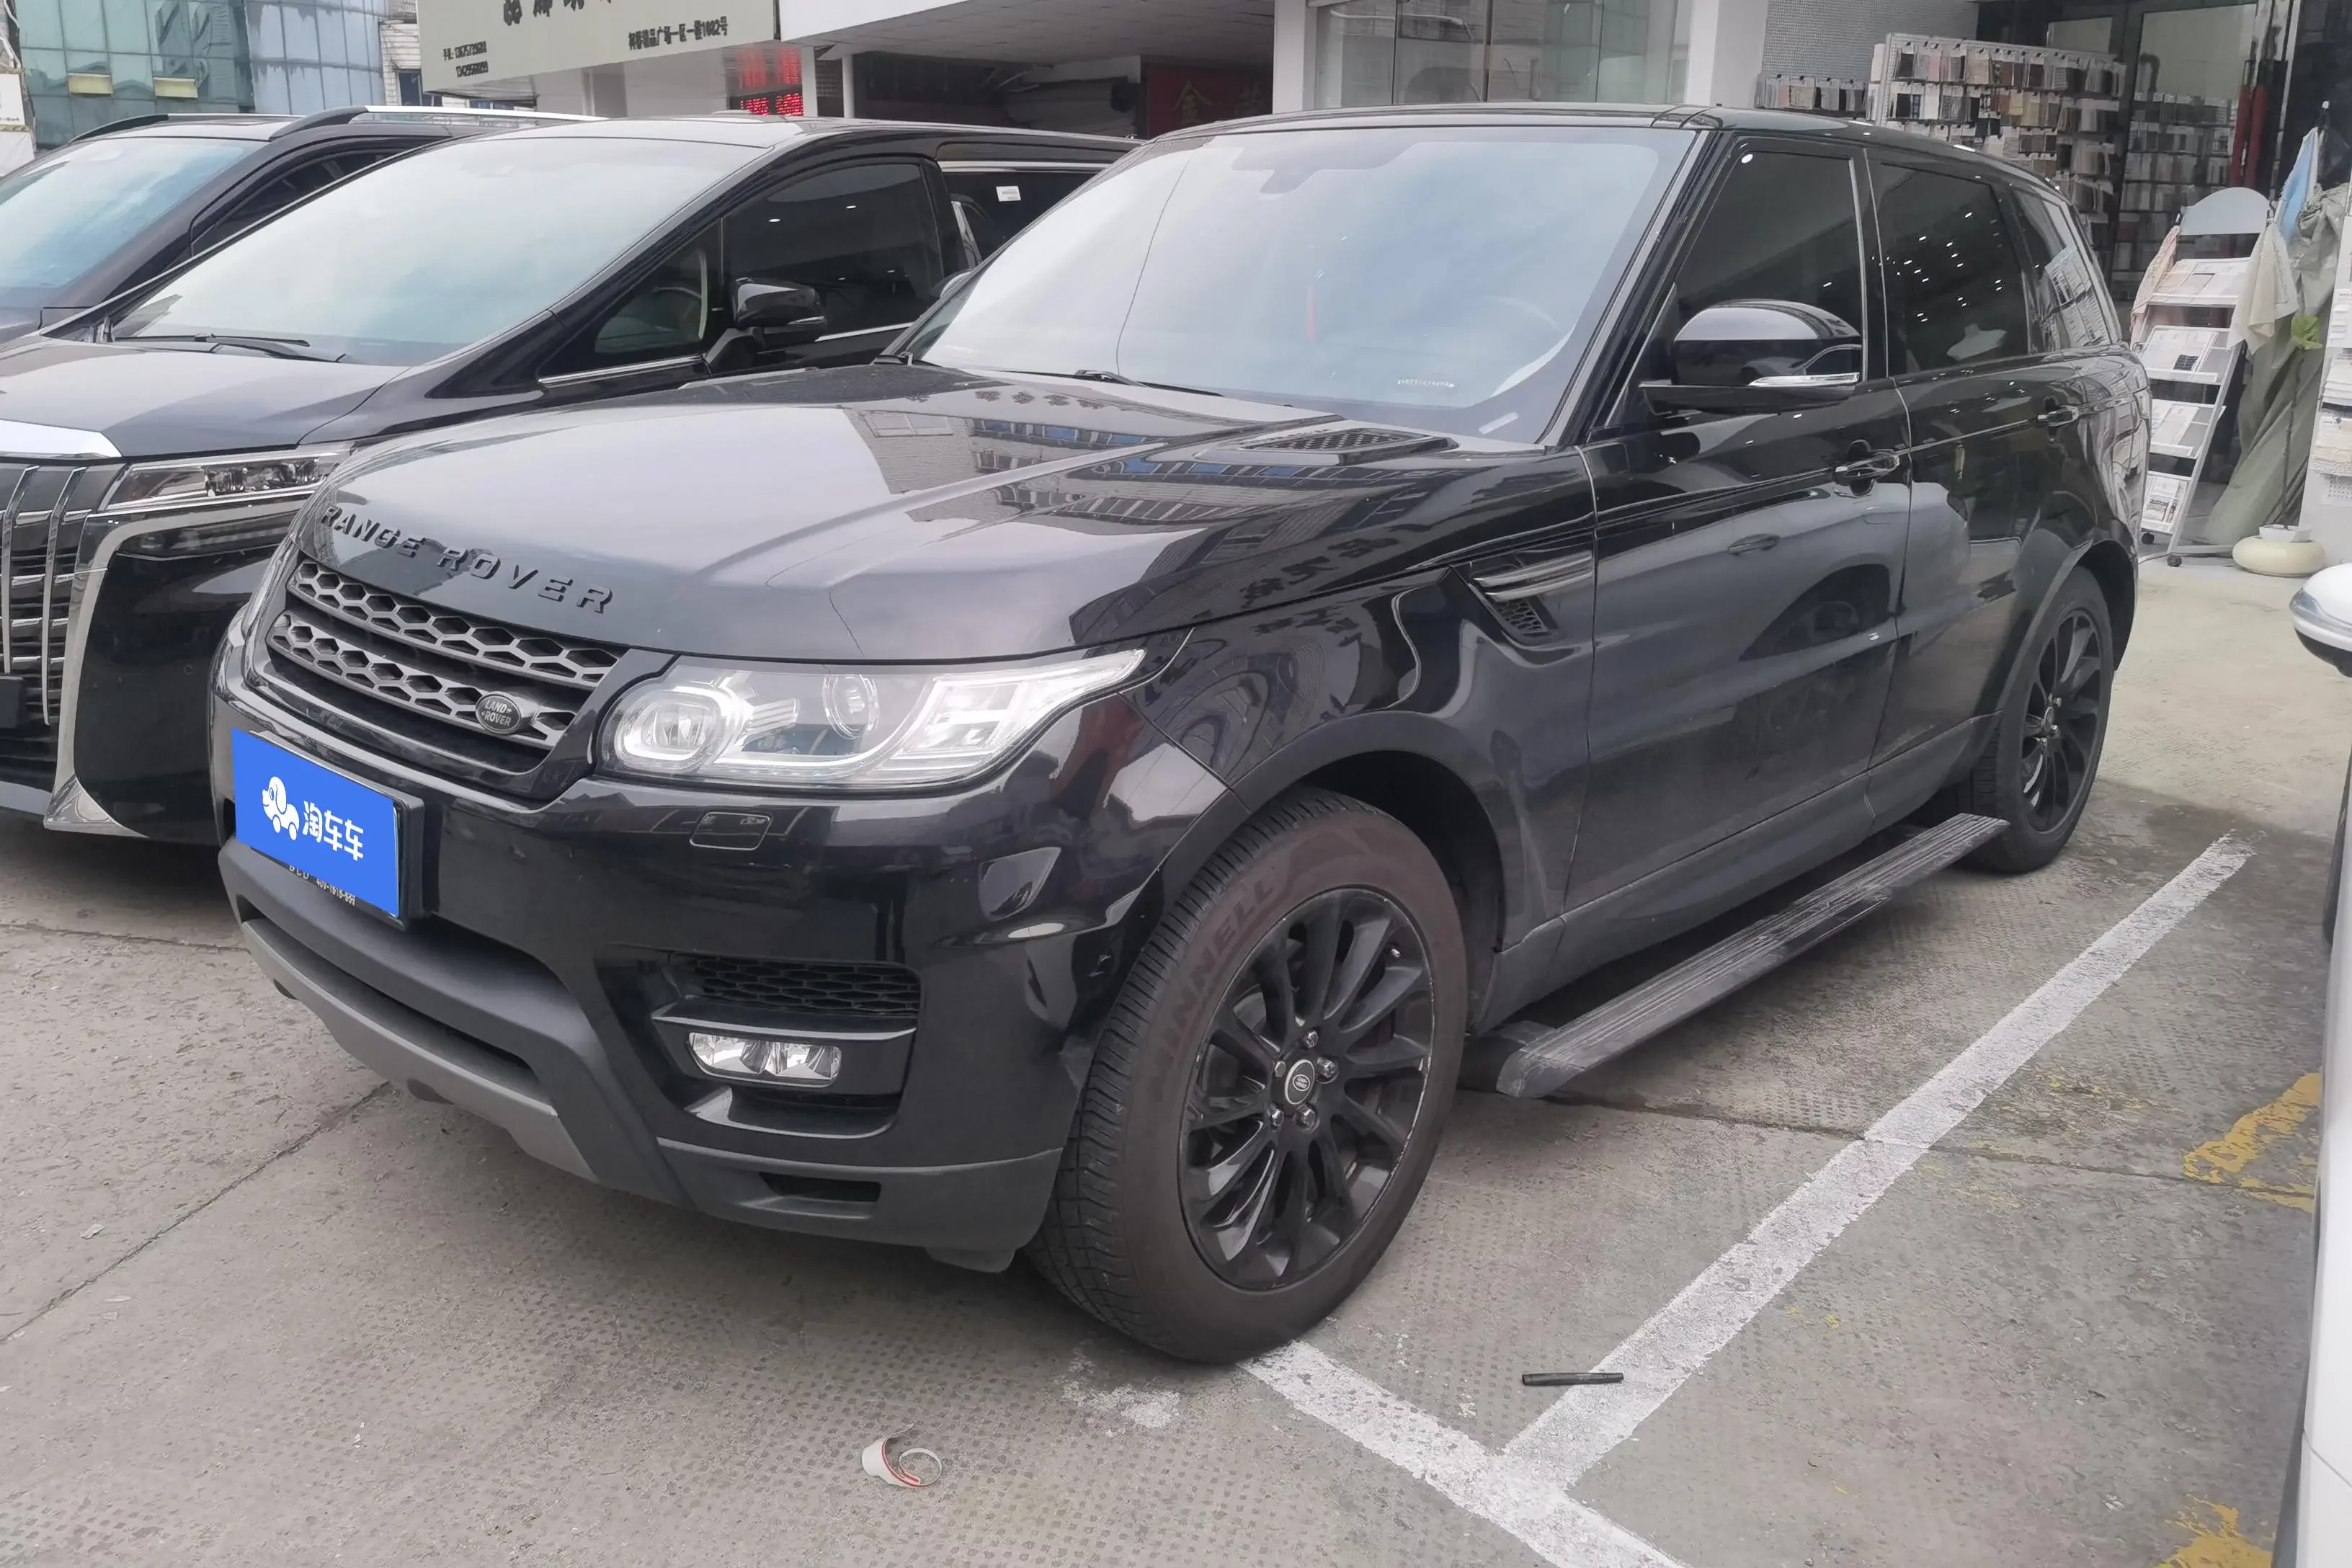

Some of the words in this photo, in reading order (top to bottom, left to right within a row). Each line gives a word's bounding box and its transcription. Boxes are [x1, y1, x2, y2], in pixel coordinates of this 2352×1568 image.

[320, 504, 426, 557] RANGE
[437, 547, 612, 614] ROVER
[485, 699, 507, 713] LAND
[484, 710, 512, 726] ROVER
